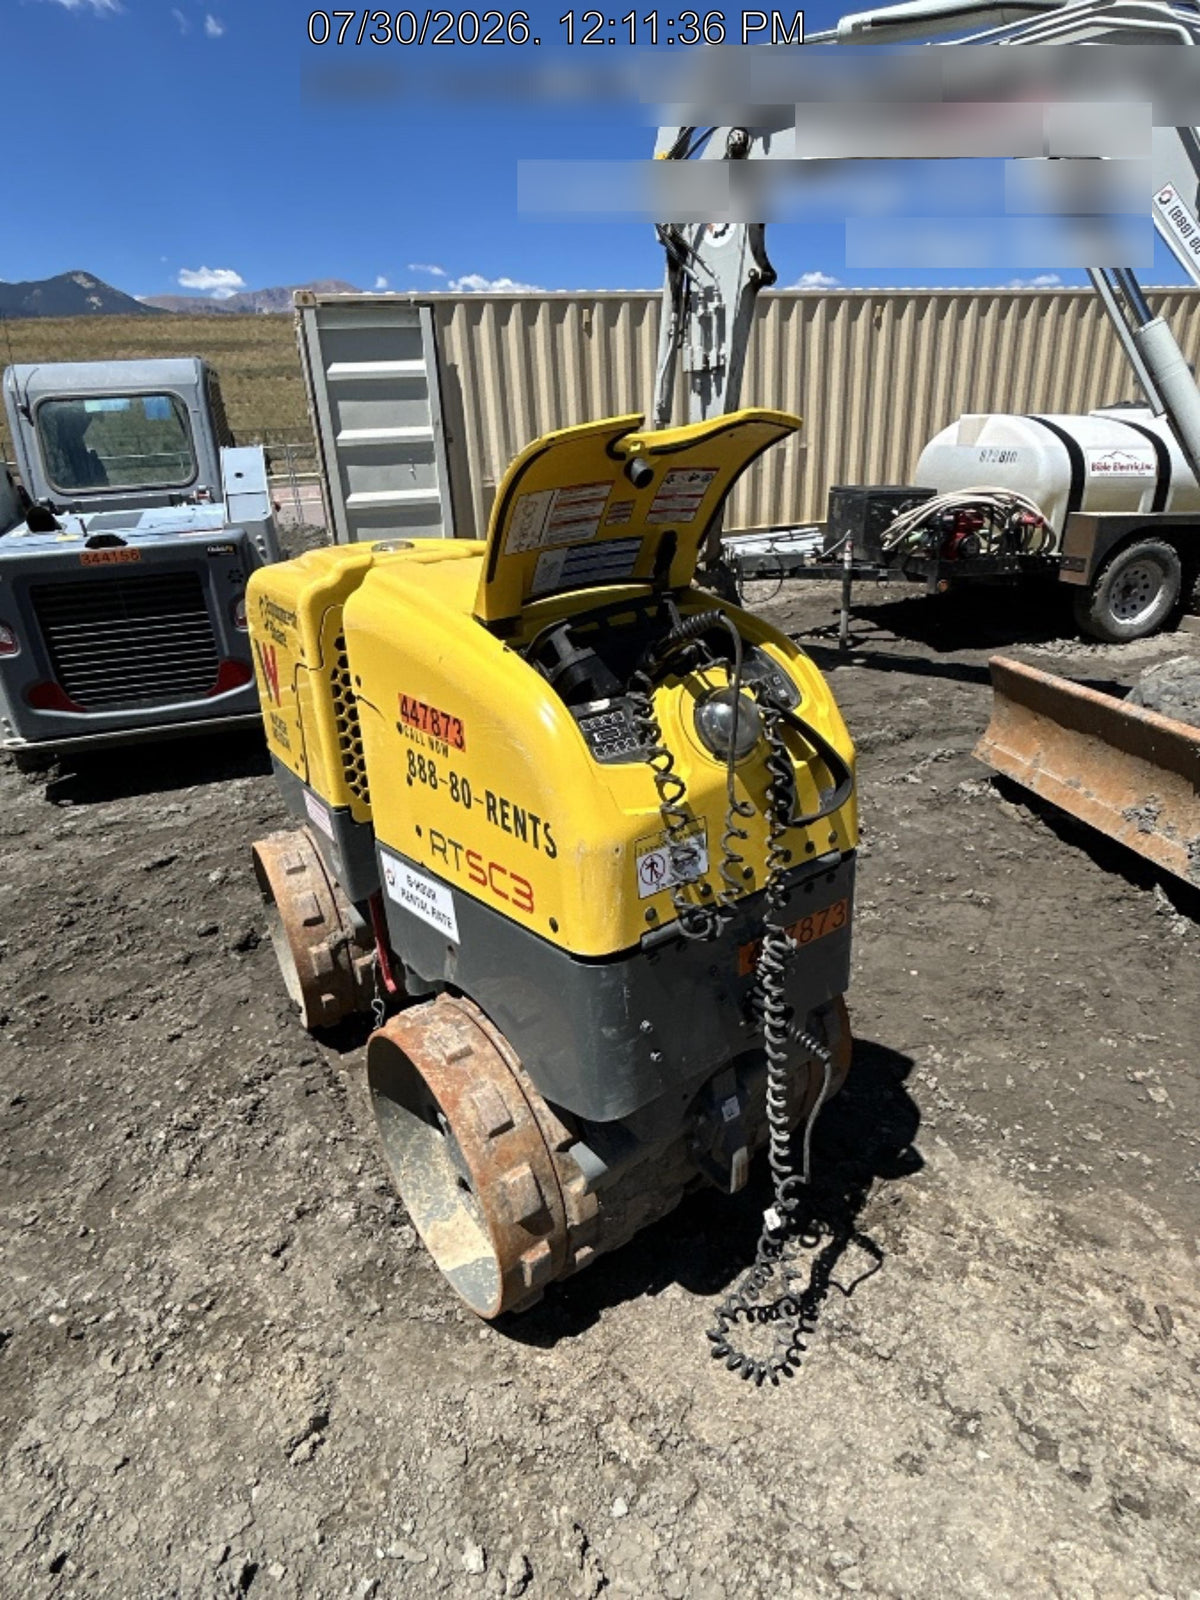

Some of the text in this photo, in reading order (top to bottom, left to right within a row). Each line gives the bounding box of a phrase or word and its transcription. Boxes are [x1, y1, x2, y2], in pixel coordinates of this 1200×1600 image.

[401, 694, 464, 750] 447873
[403, 724, 449, 758] CALL NOW
[406, 748, 558, 859] 888-80-RENTS
